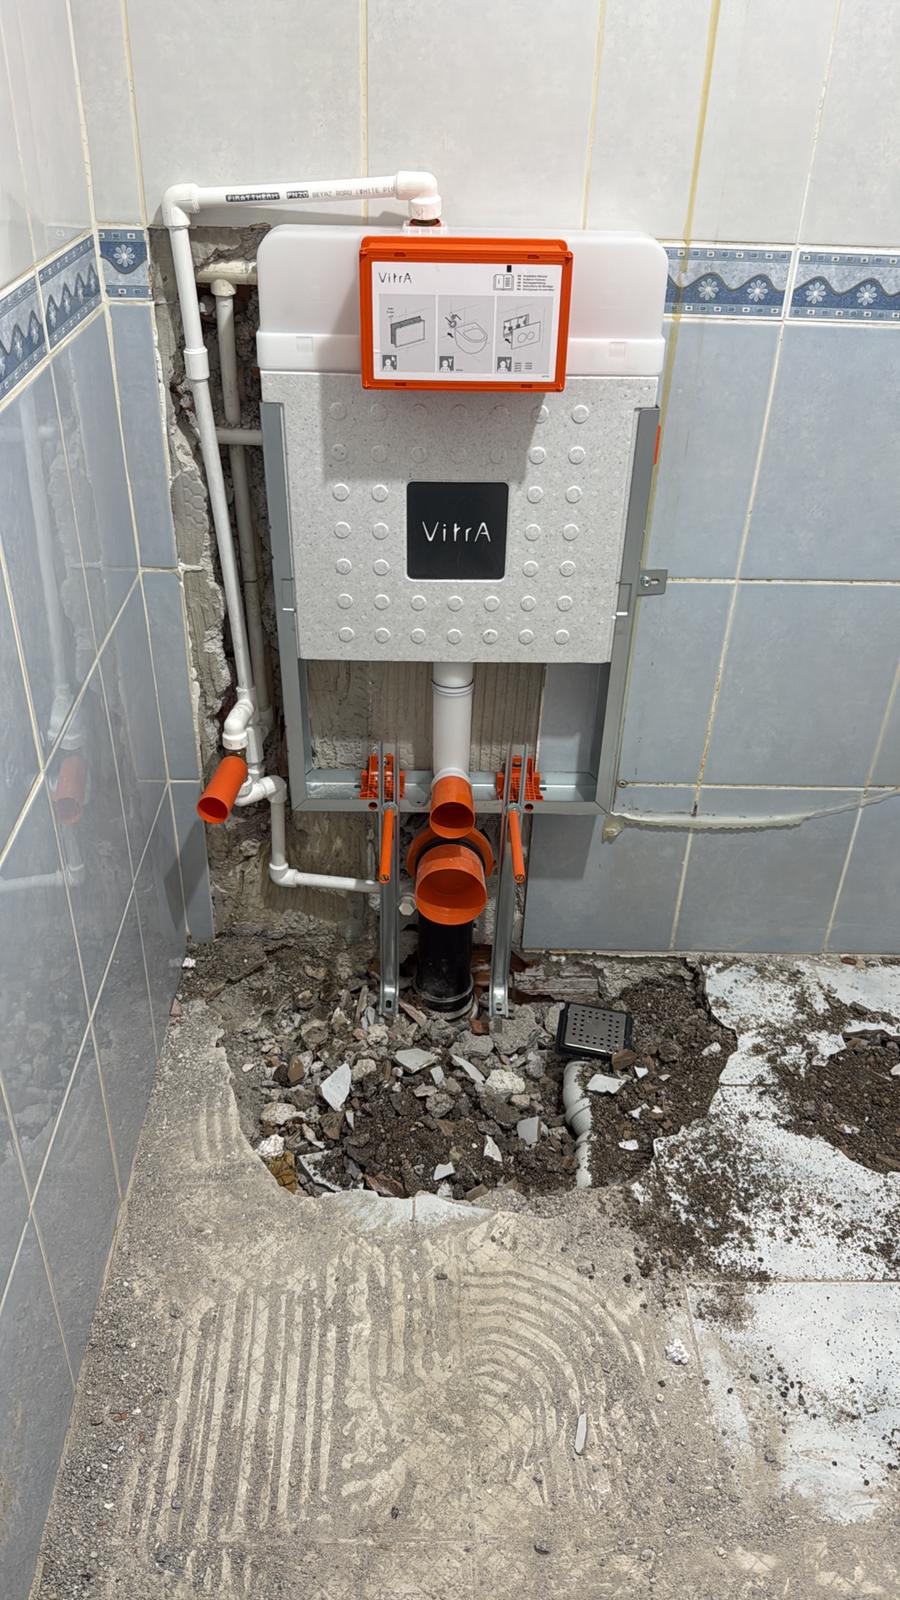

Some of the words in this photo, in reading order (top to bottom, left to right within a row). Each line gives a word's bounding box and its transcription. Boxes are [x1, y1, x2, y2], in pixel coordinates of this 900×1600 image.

[286, 191, 309, 199] PN20
[378, 272, 412, 284] VitrA
[422, 521, 491, 543] VitrA
